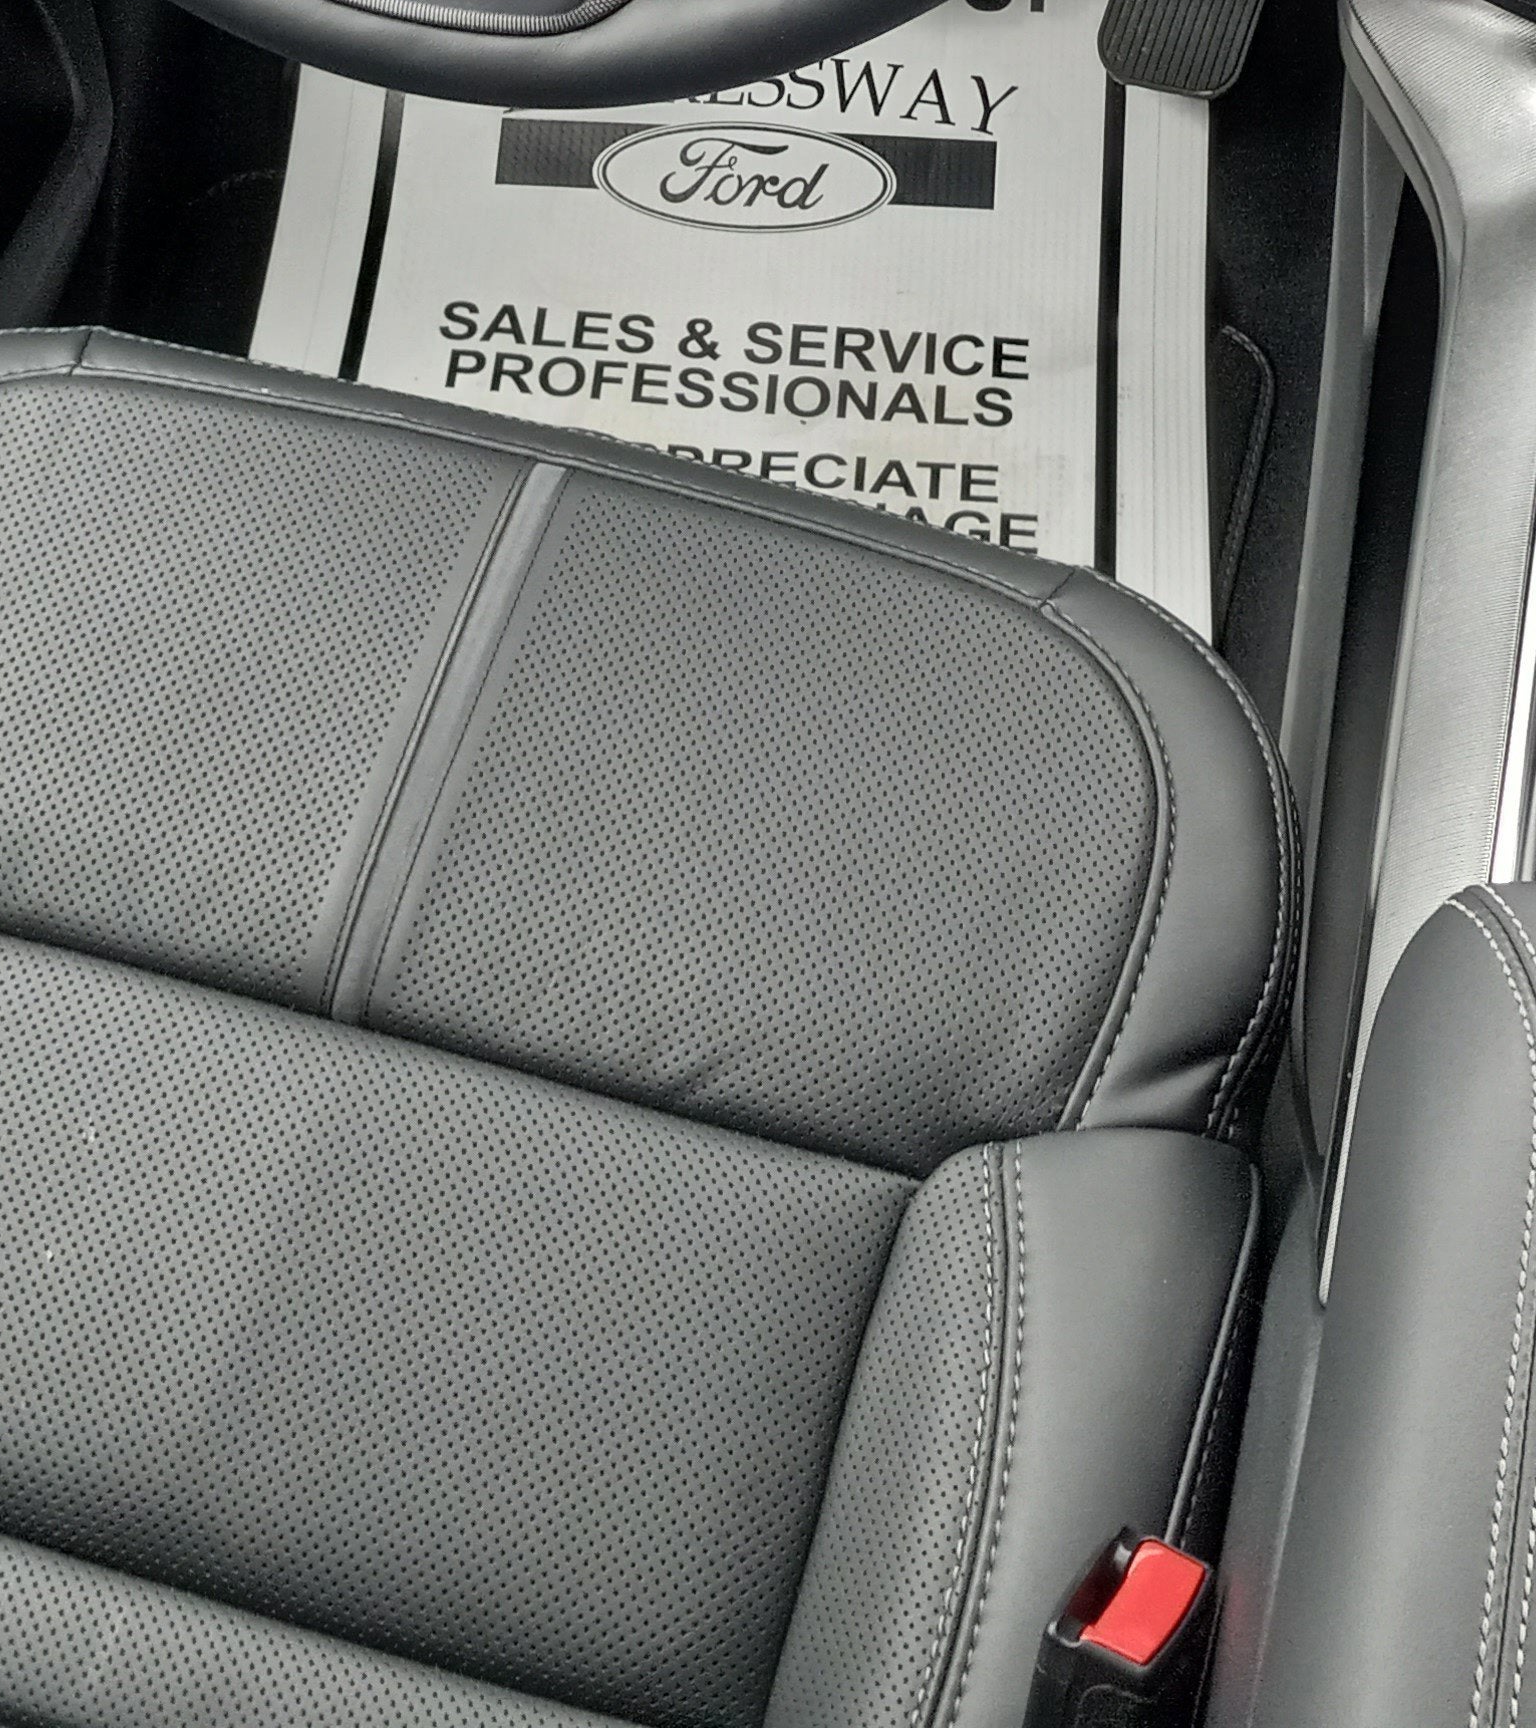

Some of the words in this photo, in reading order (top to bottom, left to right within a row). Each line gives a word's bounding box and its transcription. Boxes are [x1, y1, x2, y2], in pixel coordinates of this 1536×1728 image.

[658, 136, 831, 212] Ford
[438, 300, 656, 355] SALES
[677, 317, 723, 362] &
[743, 320, 1031, 381] SERVICE
[444, 348, 1015, 427] PROFESSIONALS
